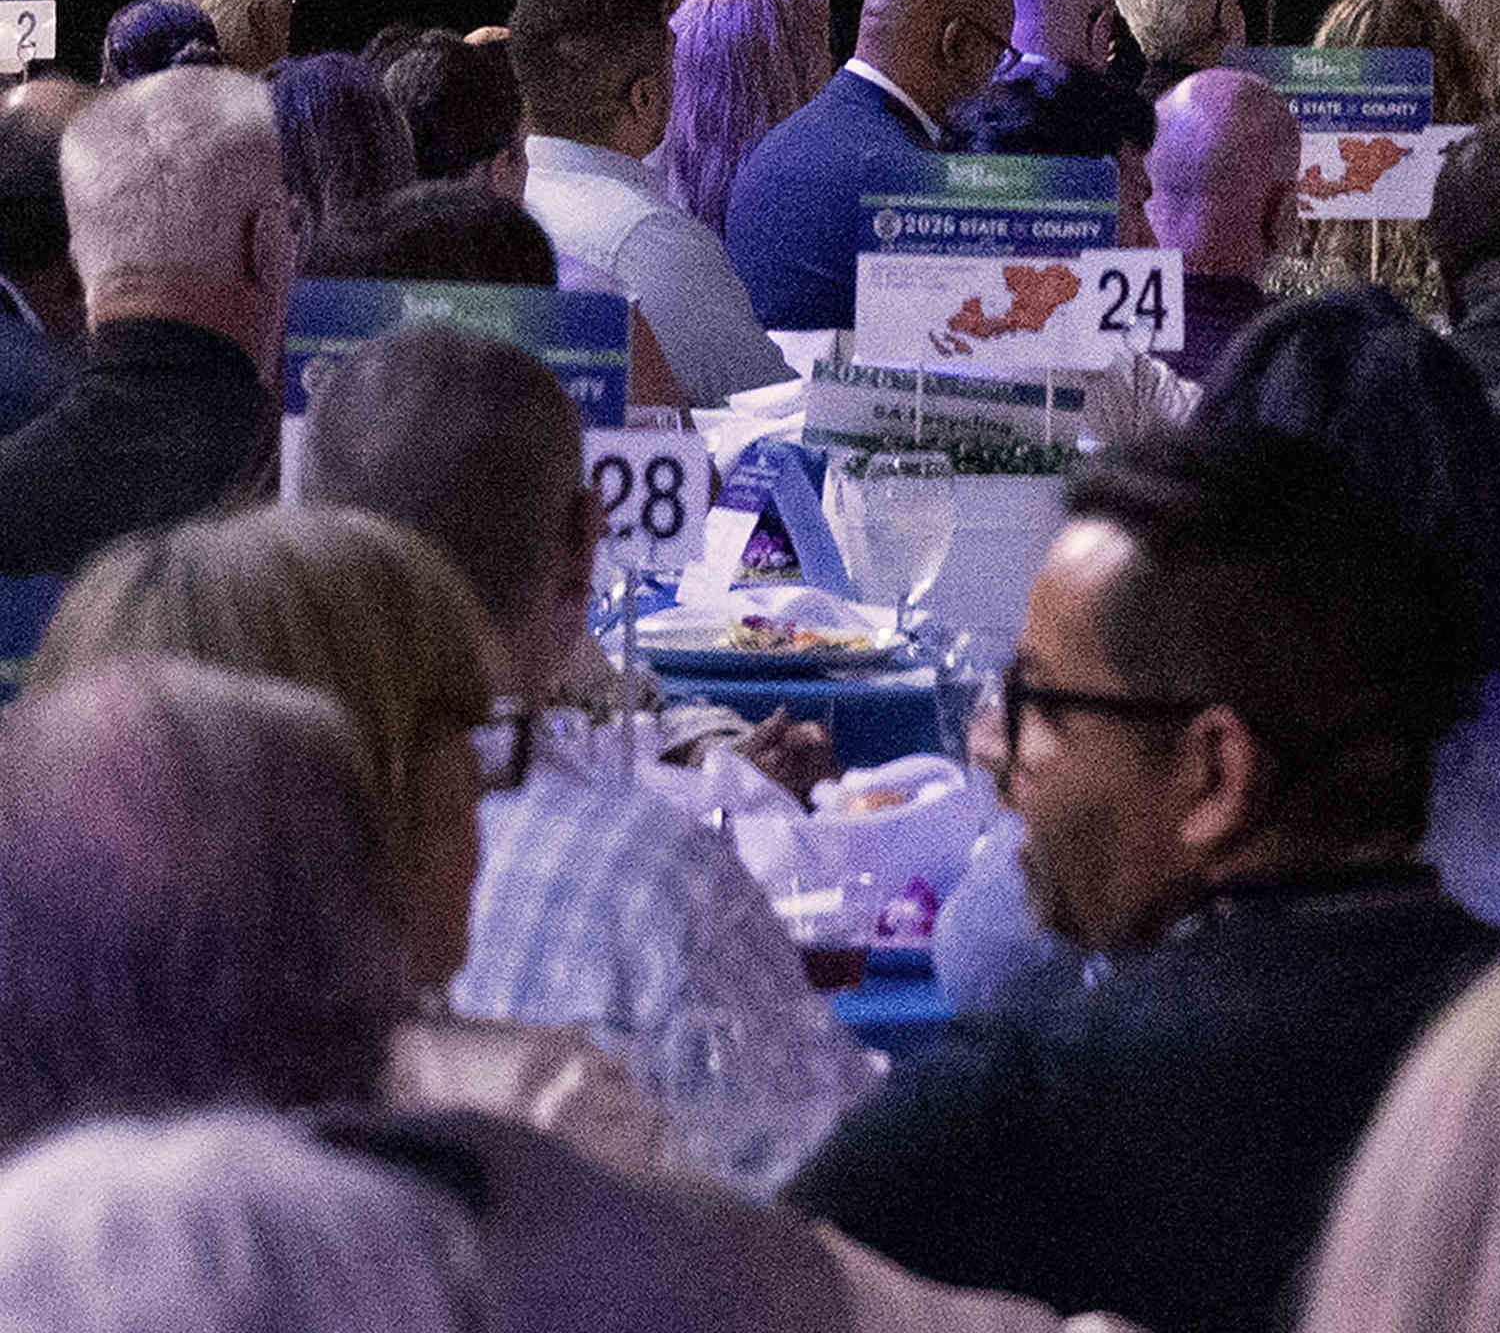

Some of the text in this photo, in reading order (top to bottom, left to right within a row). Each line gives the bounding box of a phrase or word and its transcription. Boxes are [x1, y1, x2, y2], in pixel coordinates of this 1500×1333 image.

[1302, 101, 1342, 115] STATE
[1361, 102, 1418, 116] COUNTY
[960, 219, 1008, 237] STATE
[1032, 220, 1102, 238] COUNTY
[1098, 268, 1168, 332] 24
[591, 454, 686, 540] 28
